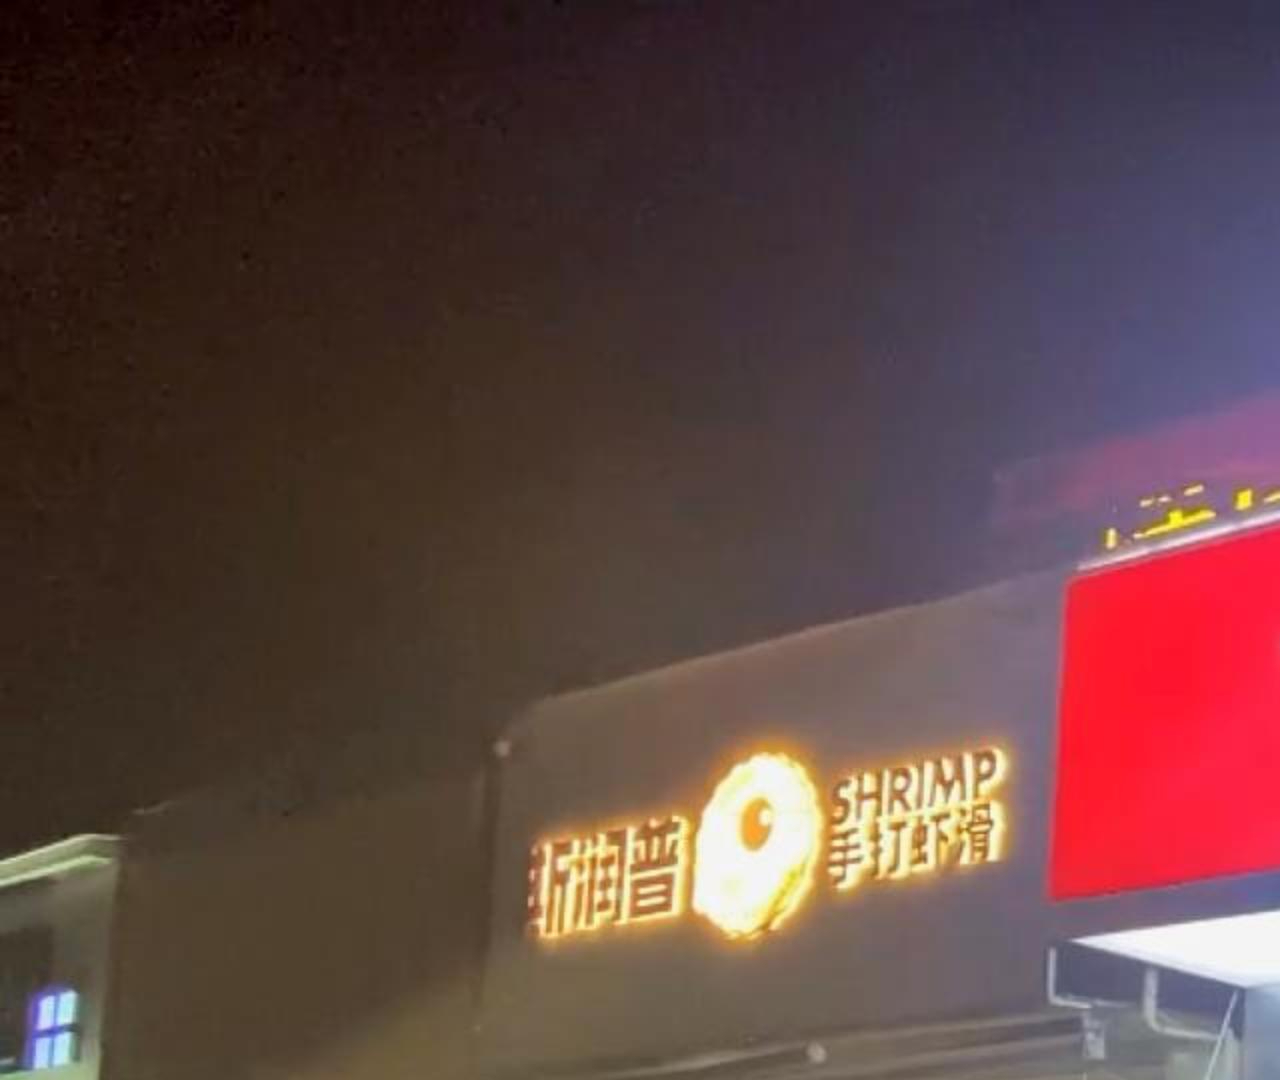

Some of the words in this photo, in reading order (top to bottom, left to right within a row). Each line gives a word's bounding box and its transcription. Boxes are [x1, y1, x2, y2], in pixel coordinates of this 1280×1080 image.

[831, 748, 1003, 826] SHRIMP
[828, 800, 1003, 888] 手打虾滑
